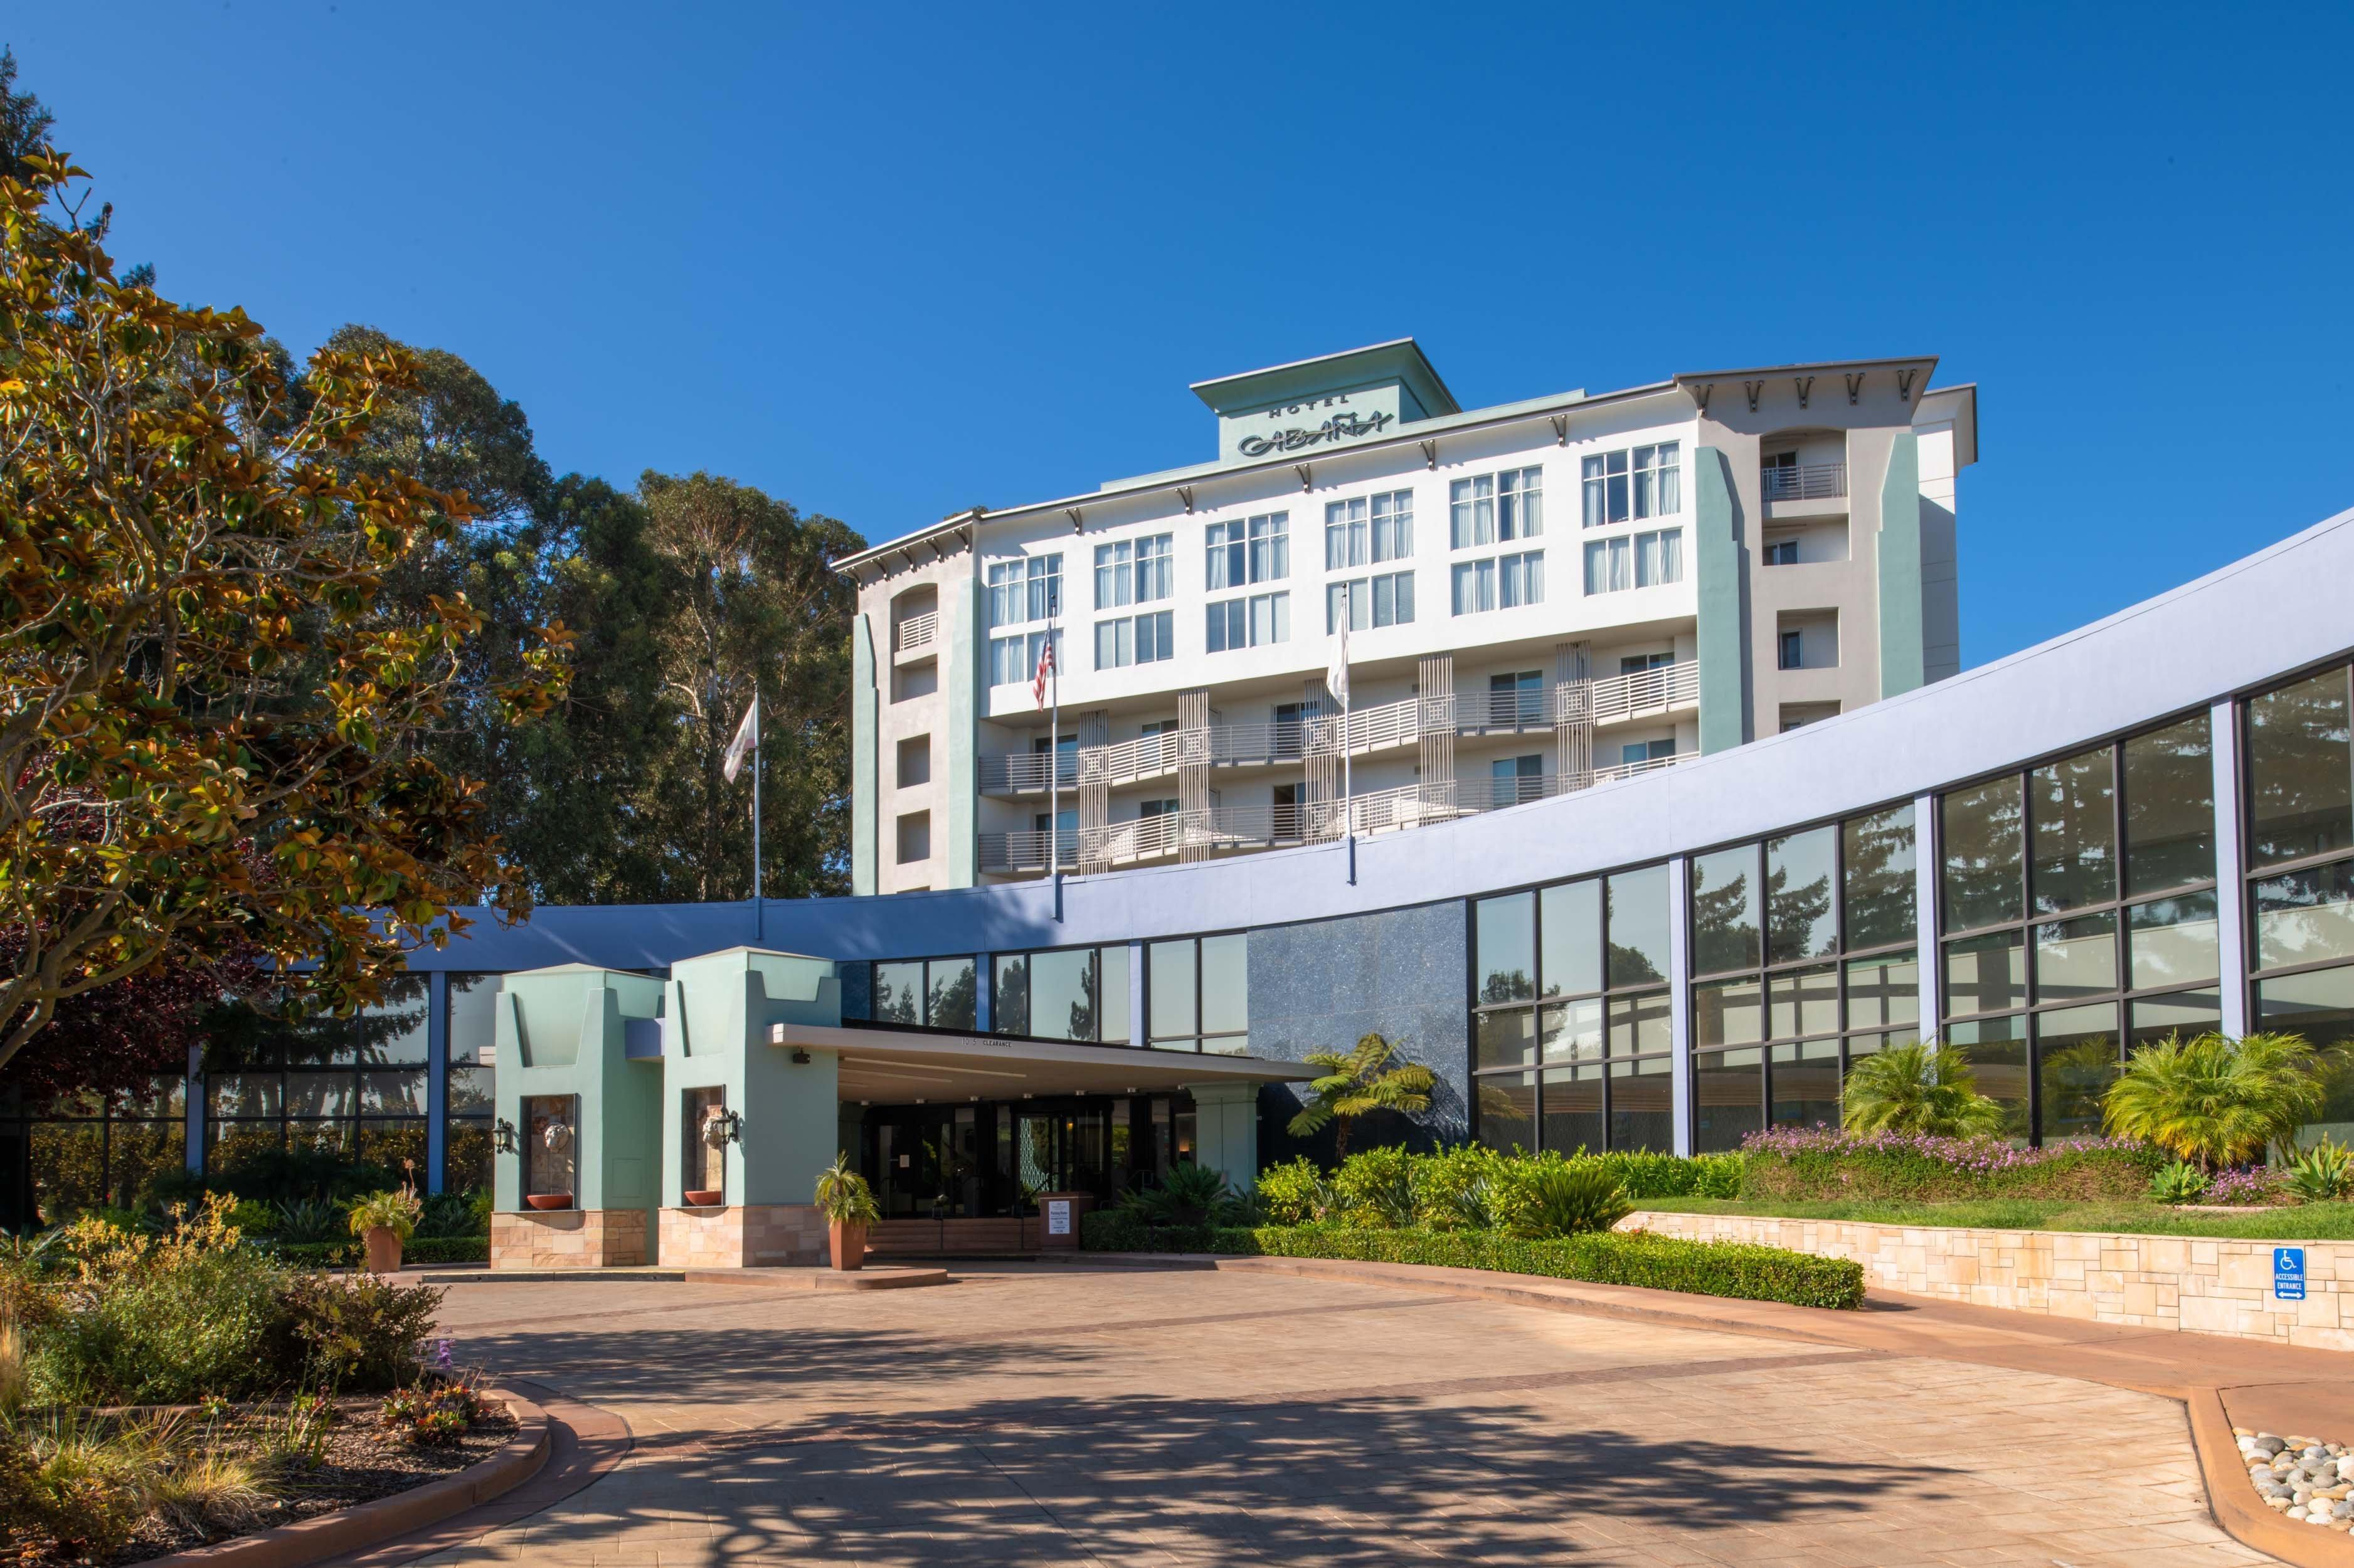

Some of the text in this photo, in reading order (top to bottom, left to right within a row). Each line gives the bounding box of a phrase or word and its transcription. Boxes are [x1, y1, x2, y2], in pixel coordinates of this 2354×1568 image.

[1269, 395, 1349, 418] HOTEL
[2275, 1273, 2303, 1281] ACCESSIBLE
[2277, 1282, 2302, 1290] ENTRANCE
